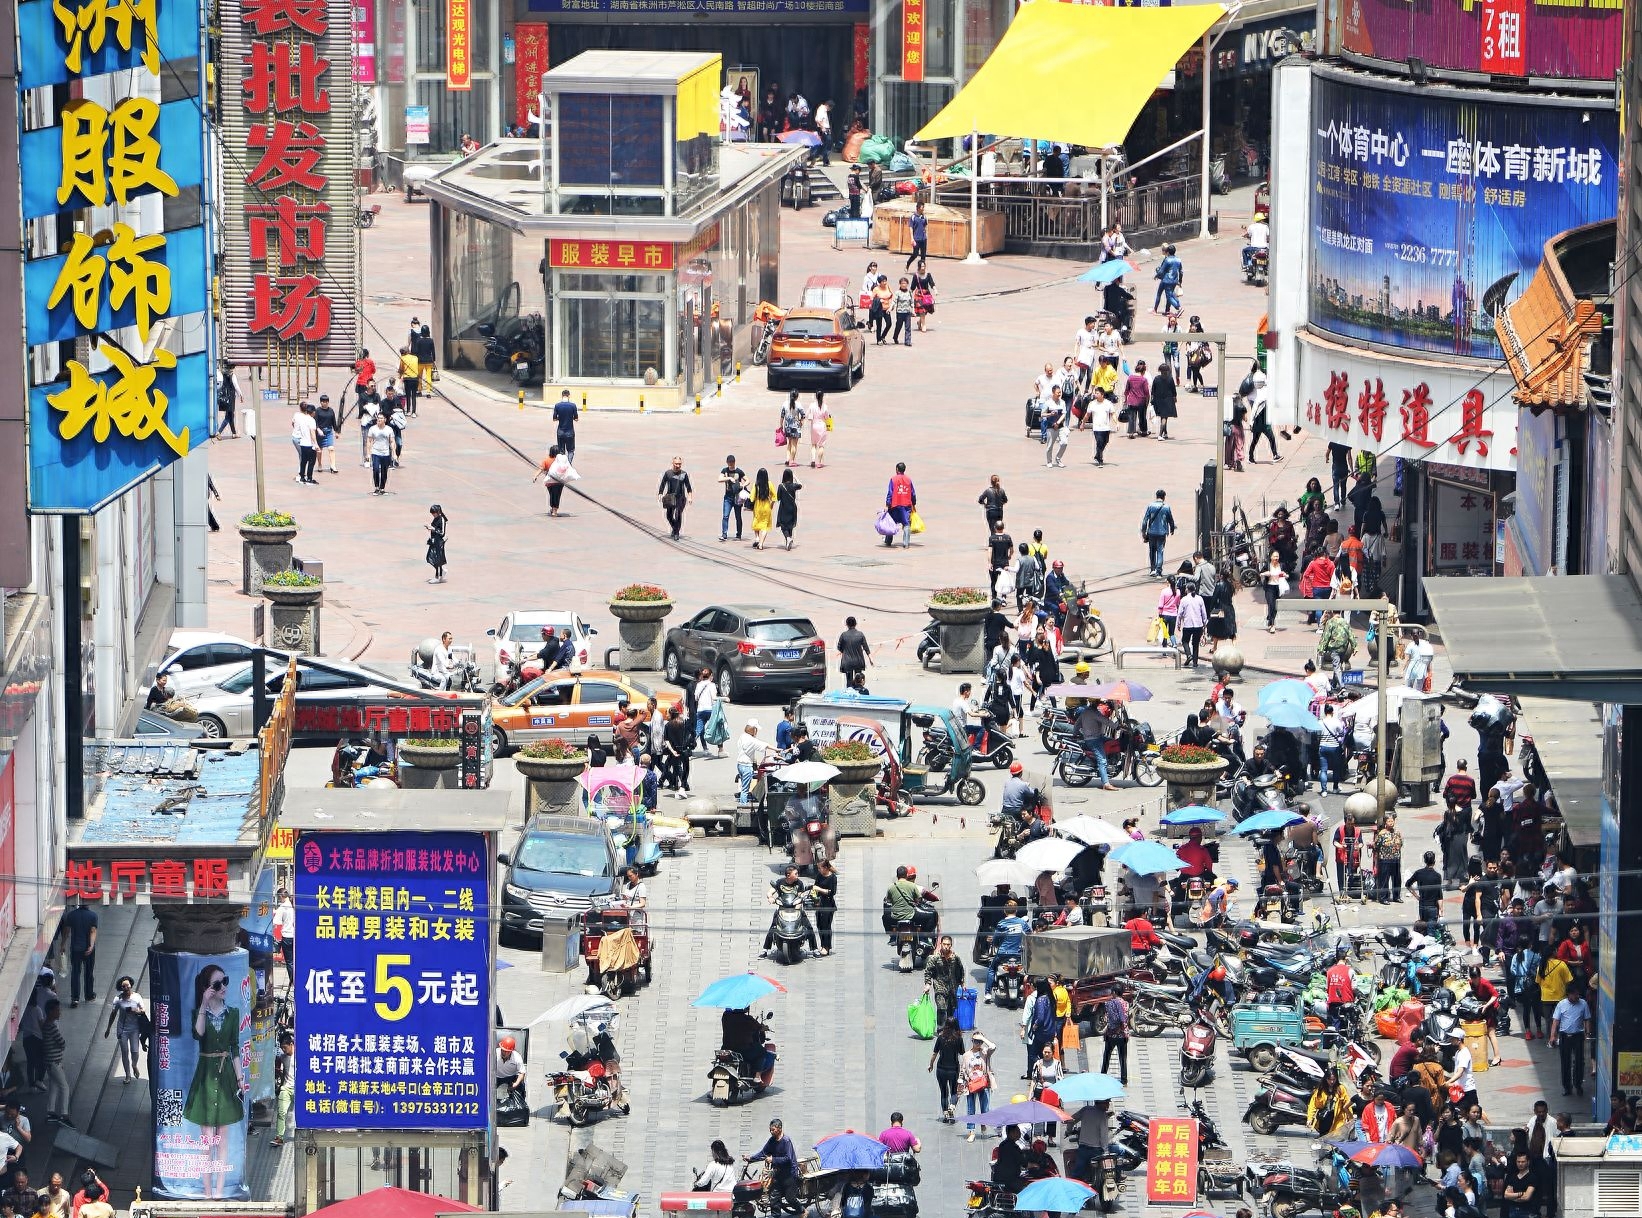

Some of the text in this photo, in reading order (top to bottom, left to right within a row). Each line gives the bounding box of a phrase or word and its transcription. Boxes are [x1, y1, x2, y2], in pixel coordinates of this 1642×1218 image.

[450, 0, 466, 76] 达观光电梯
[1483, 0, 1496, 60] 73
[1498, 10, 1521, 59] 租
[1317, 119, 1603, 186] 一个体育中心 一座体育新城
[1382, 175, 1433, 198] 全资源社区
[1484, 186, 1527, 208] 舒适房
[48, 0, 190, 458] 洲服饰城
[561, 243, 663, 268] 服装早市
[1400, 243, 1426, 263] 2236
[1323, 370, 1517, 458] 模特道具
[65, 858, 229, 900] 地厅童服
[329, 847, 480, 873] 大东品牌折扣服装批发中心
[316, 885, 474, 912] 长年批发国内一、二线
[316, 915, 475, 941] 品牌男装和女装
[305, 954, 479, 1021] 低至5元起
[308, 1033, 475, 1054] 诚招各大服装卖场、超市及
[309, 1056, 475, 1075] 电子网络批发商前来合作共赢
[1154, 1124, 1173, 1195] 严禁停车
[1172, 1125, 1190, 1195] 后果自负
